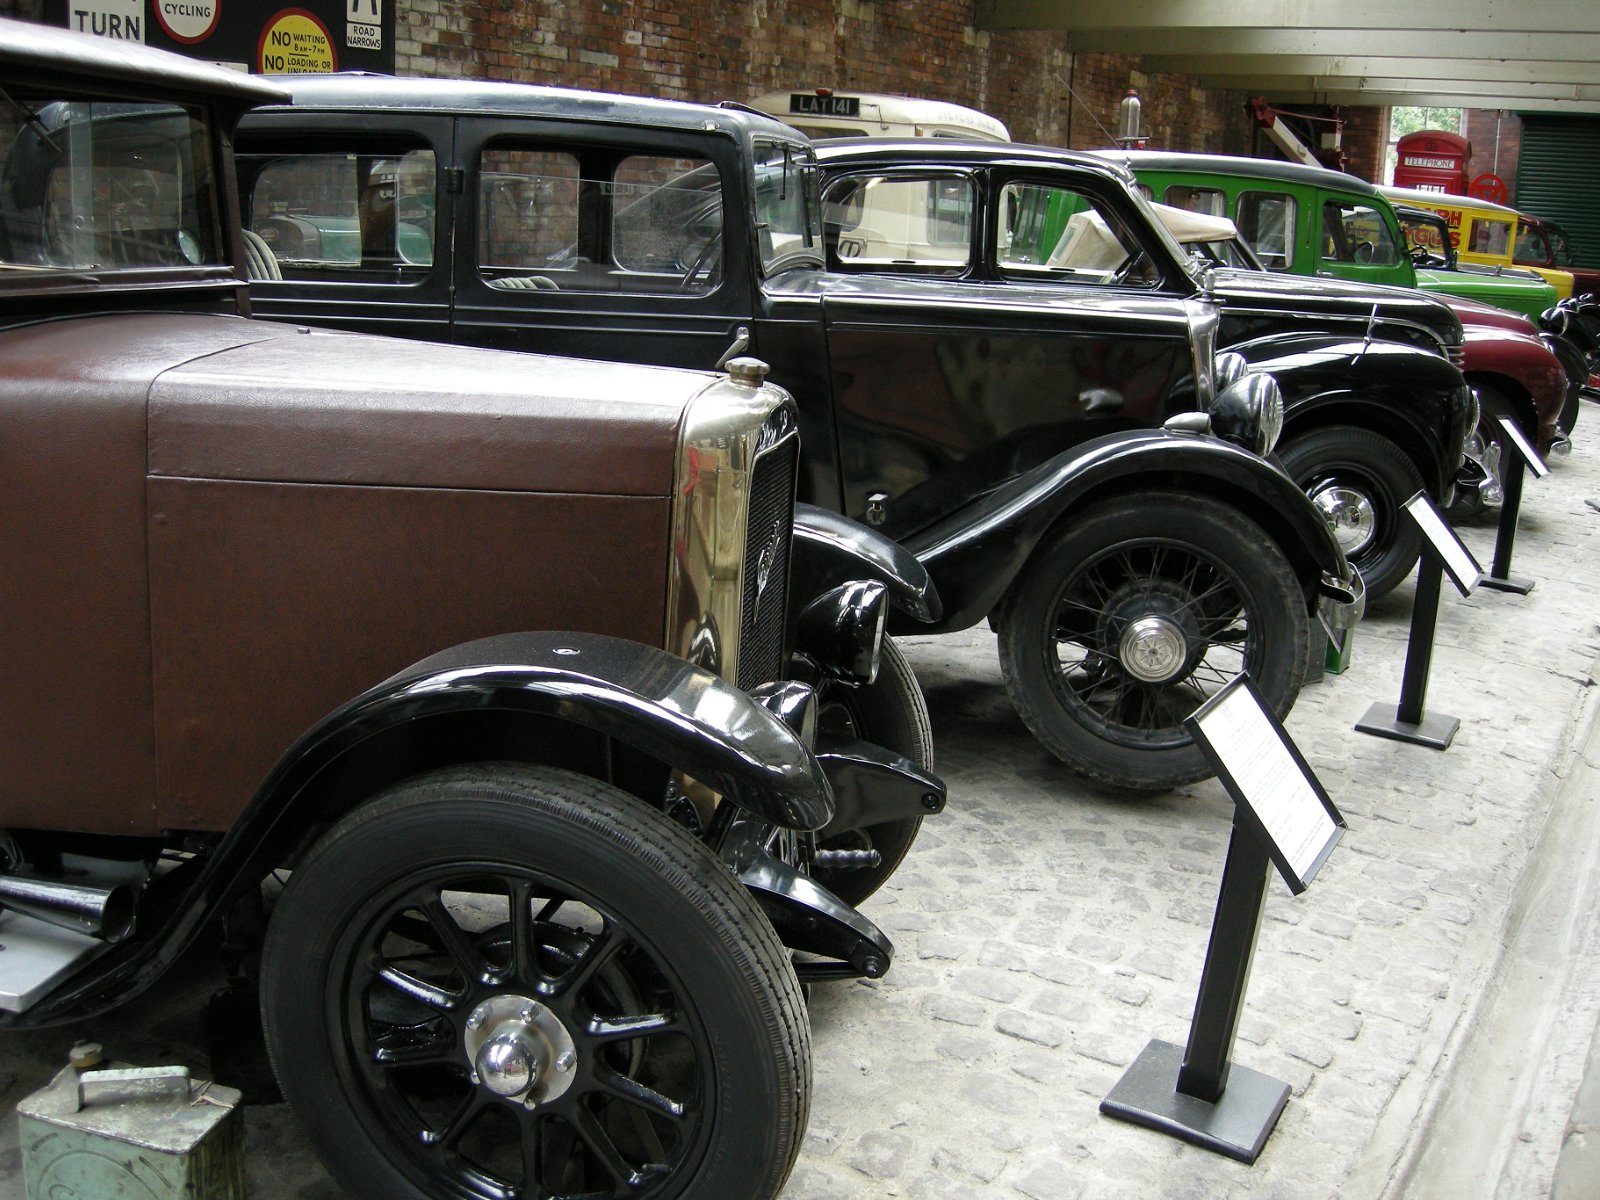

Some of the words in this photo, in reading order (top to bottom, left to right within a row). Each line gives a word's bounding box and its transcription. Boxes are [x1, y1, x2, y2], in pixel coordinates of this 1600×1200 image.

[164, 3, 211, 18] CYCLING
[74, 10, 140, 40] TURN
[353, 25, 375, 37] ROAD
[271, 30, 292, 46] NO
[293, 33, 326, 44] WAITING
[347, 36, 380, 48] NARROWS
[264, 54, 285, 71] NO
[287, 57, 319, 68] LOADING
[321, 61, 331, 69] OR
[800, 96, 829, 114] LAT
[831, 98, 850, 114] 141
[1406, 157, 1454, 168] TELEPHONE
